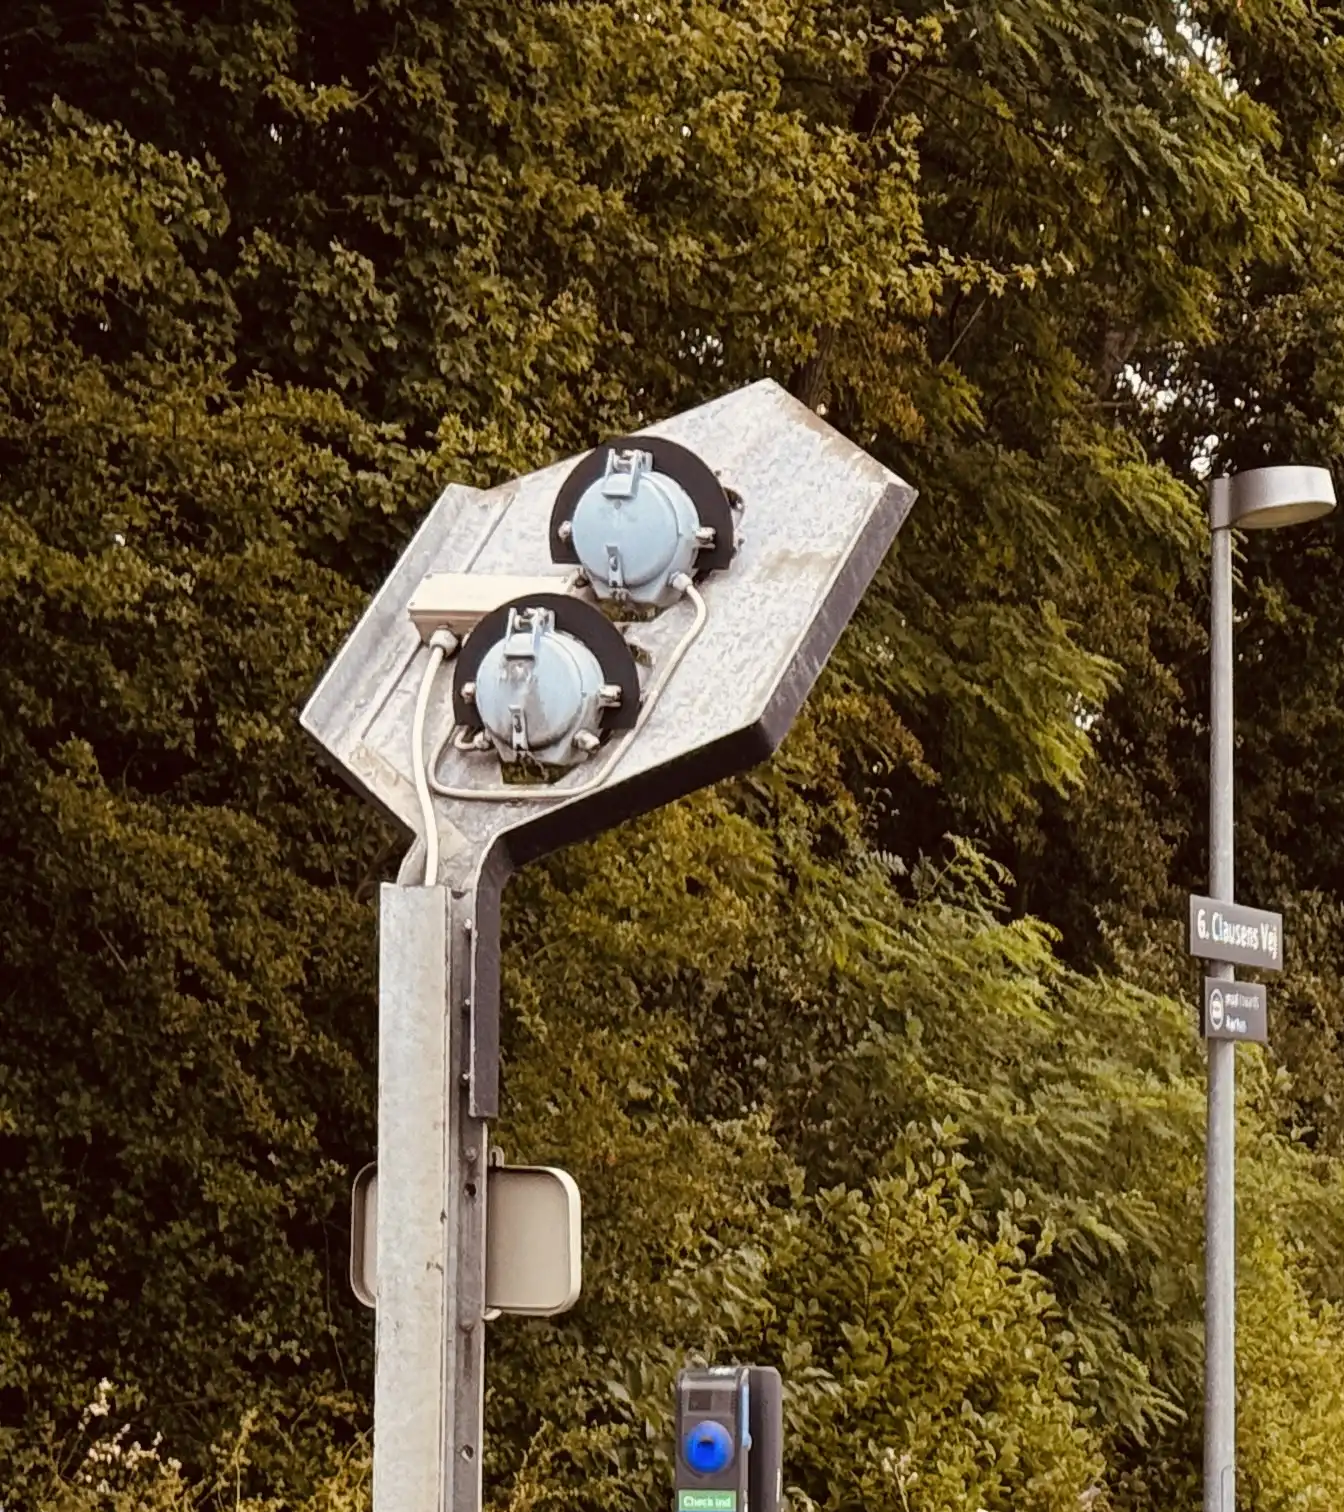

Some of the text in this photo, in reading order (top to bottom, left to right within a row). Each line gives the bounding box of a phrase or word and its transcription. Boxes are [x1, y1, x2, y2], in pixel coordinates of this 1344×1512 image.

[1212, 911, 1259, 951] Clausens
[1260, 922, 1278, 960] Vej
[683, 1495, 713, 1508] Check
